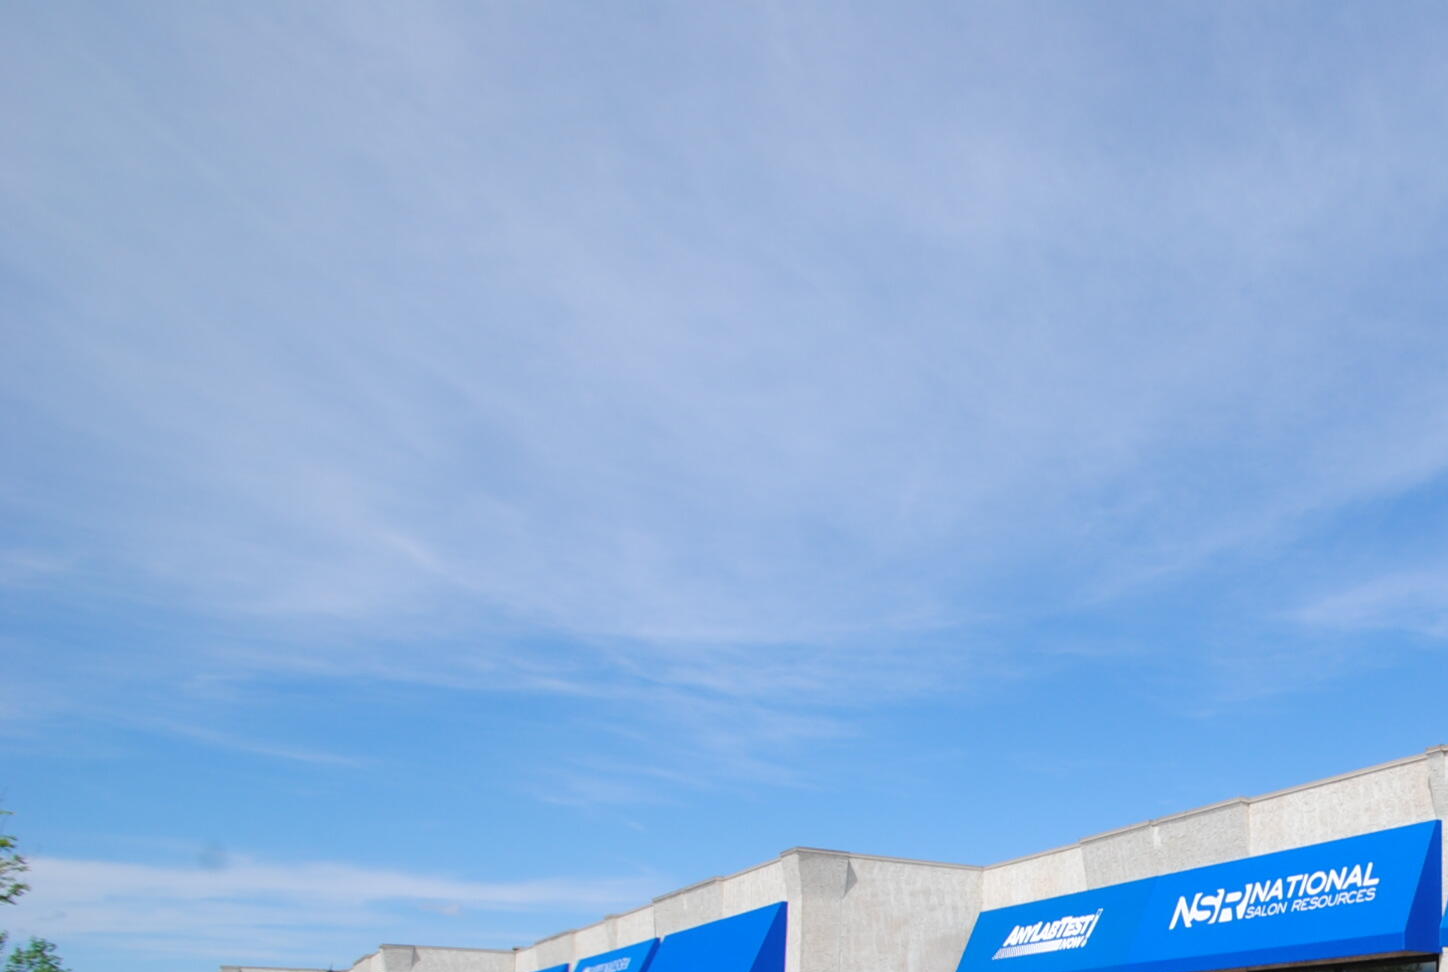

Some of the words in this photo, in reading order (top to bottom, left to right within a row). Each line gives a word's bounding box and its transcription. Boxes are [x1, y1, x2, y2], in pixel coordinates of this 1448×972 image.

[1251, 861, 1380, 905] NATIONAL
[1244, 901, 1288, 919] SALON
[1290, 887, 1377, 912] RESOURCES
